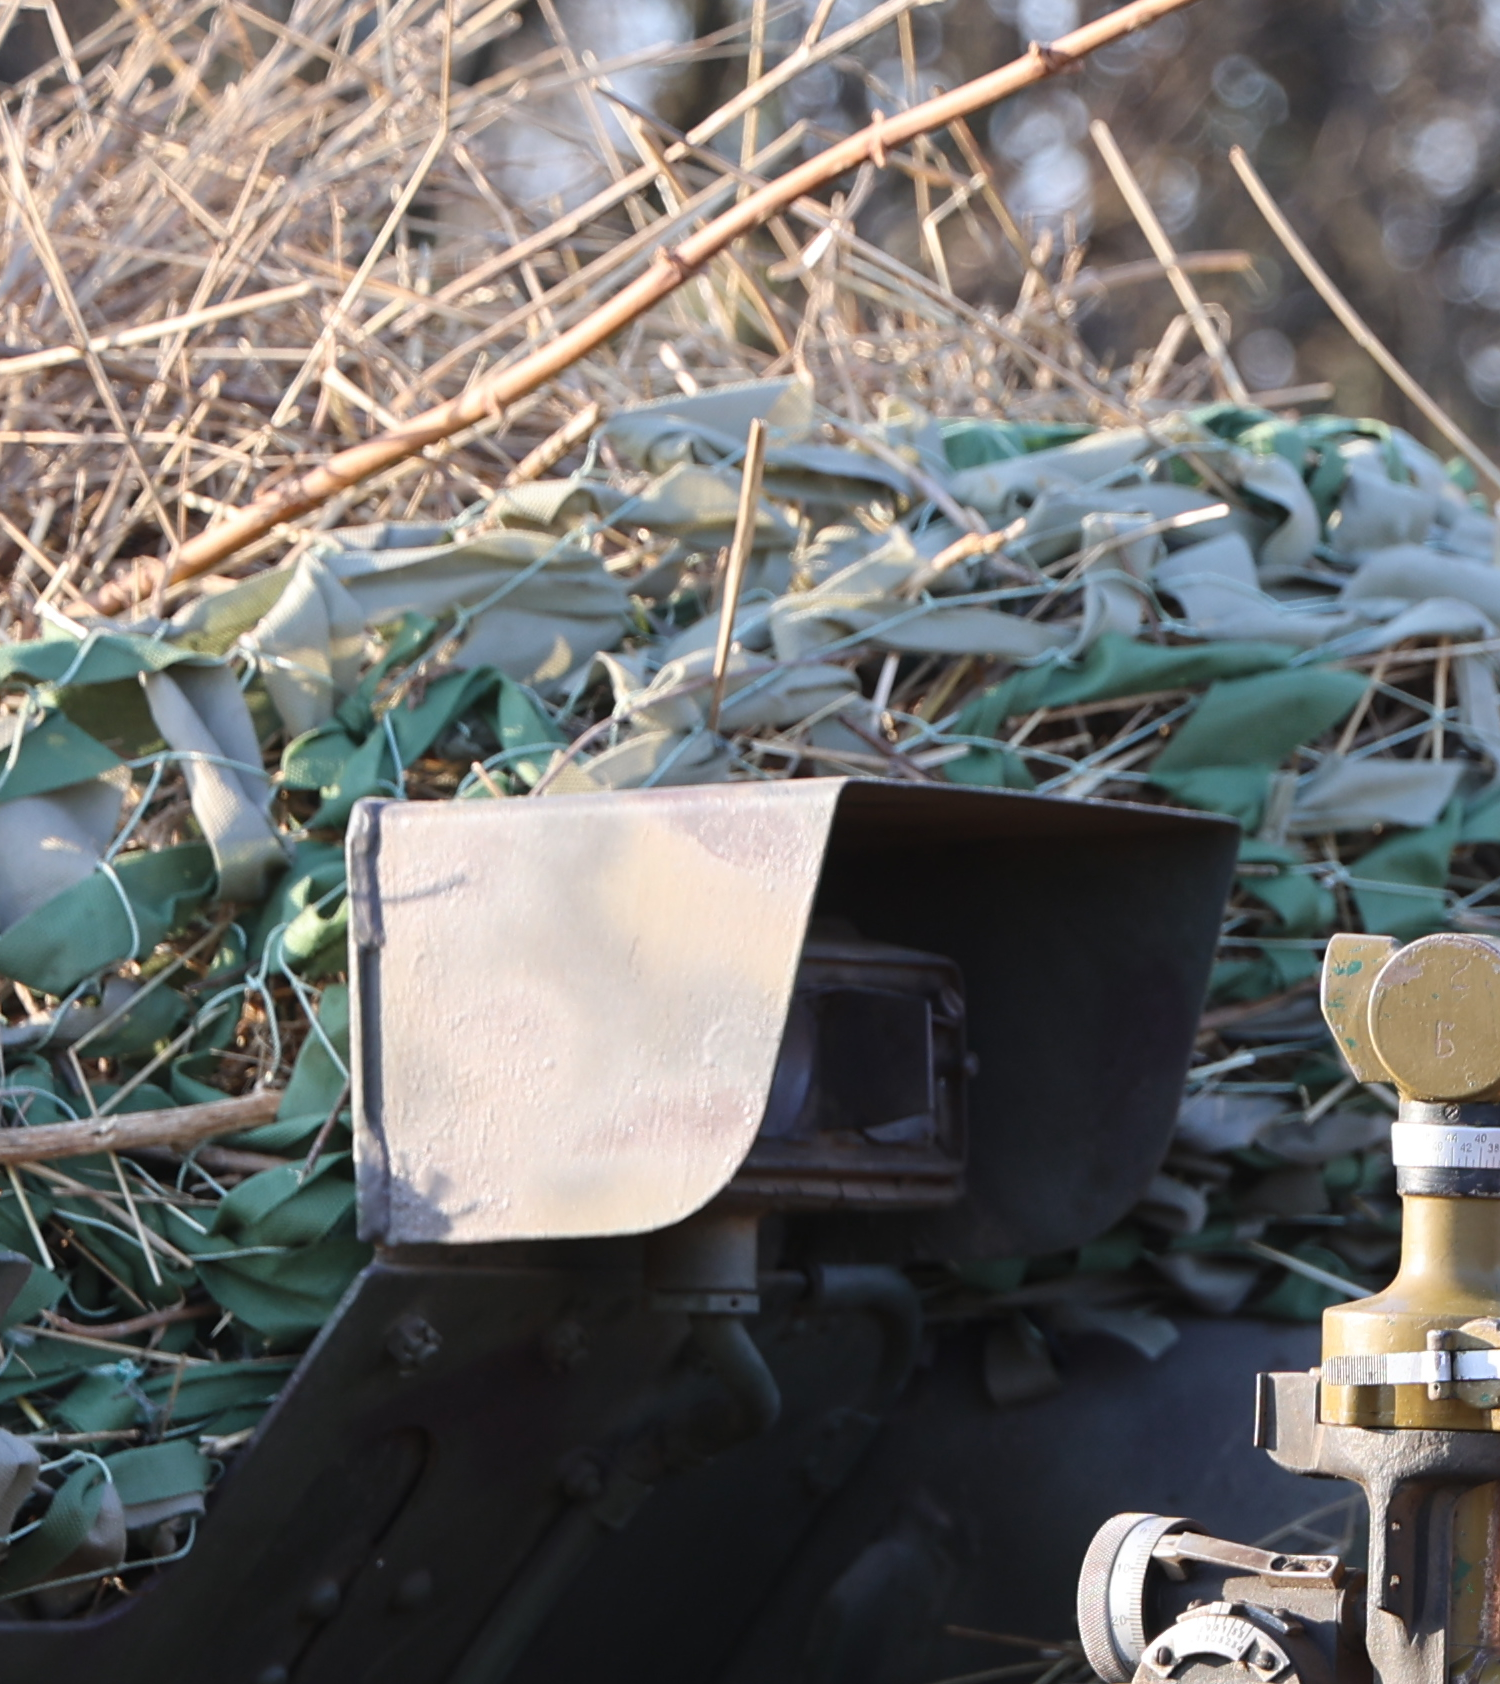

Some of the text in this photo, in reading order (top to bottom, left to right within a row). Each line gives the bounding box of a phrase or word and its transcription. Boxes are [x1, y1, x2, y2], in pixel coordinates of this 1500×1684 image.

[1474, 1133, 1488, 1144] 40
[1460, 1142, 1473, 1153] 42
[1487, 1143, 1500, 1154] 38
[1116, 1562, 1131, 1574] 10
[1112, 1615, 1127, 1627] 20
